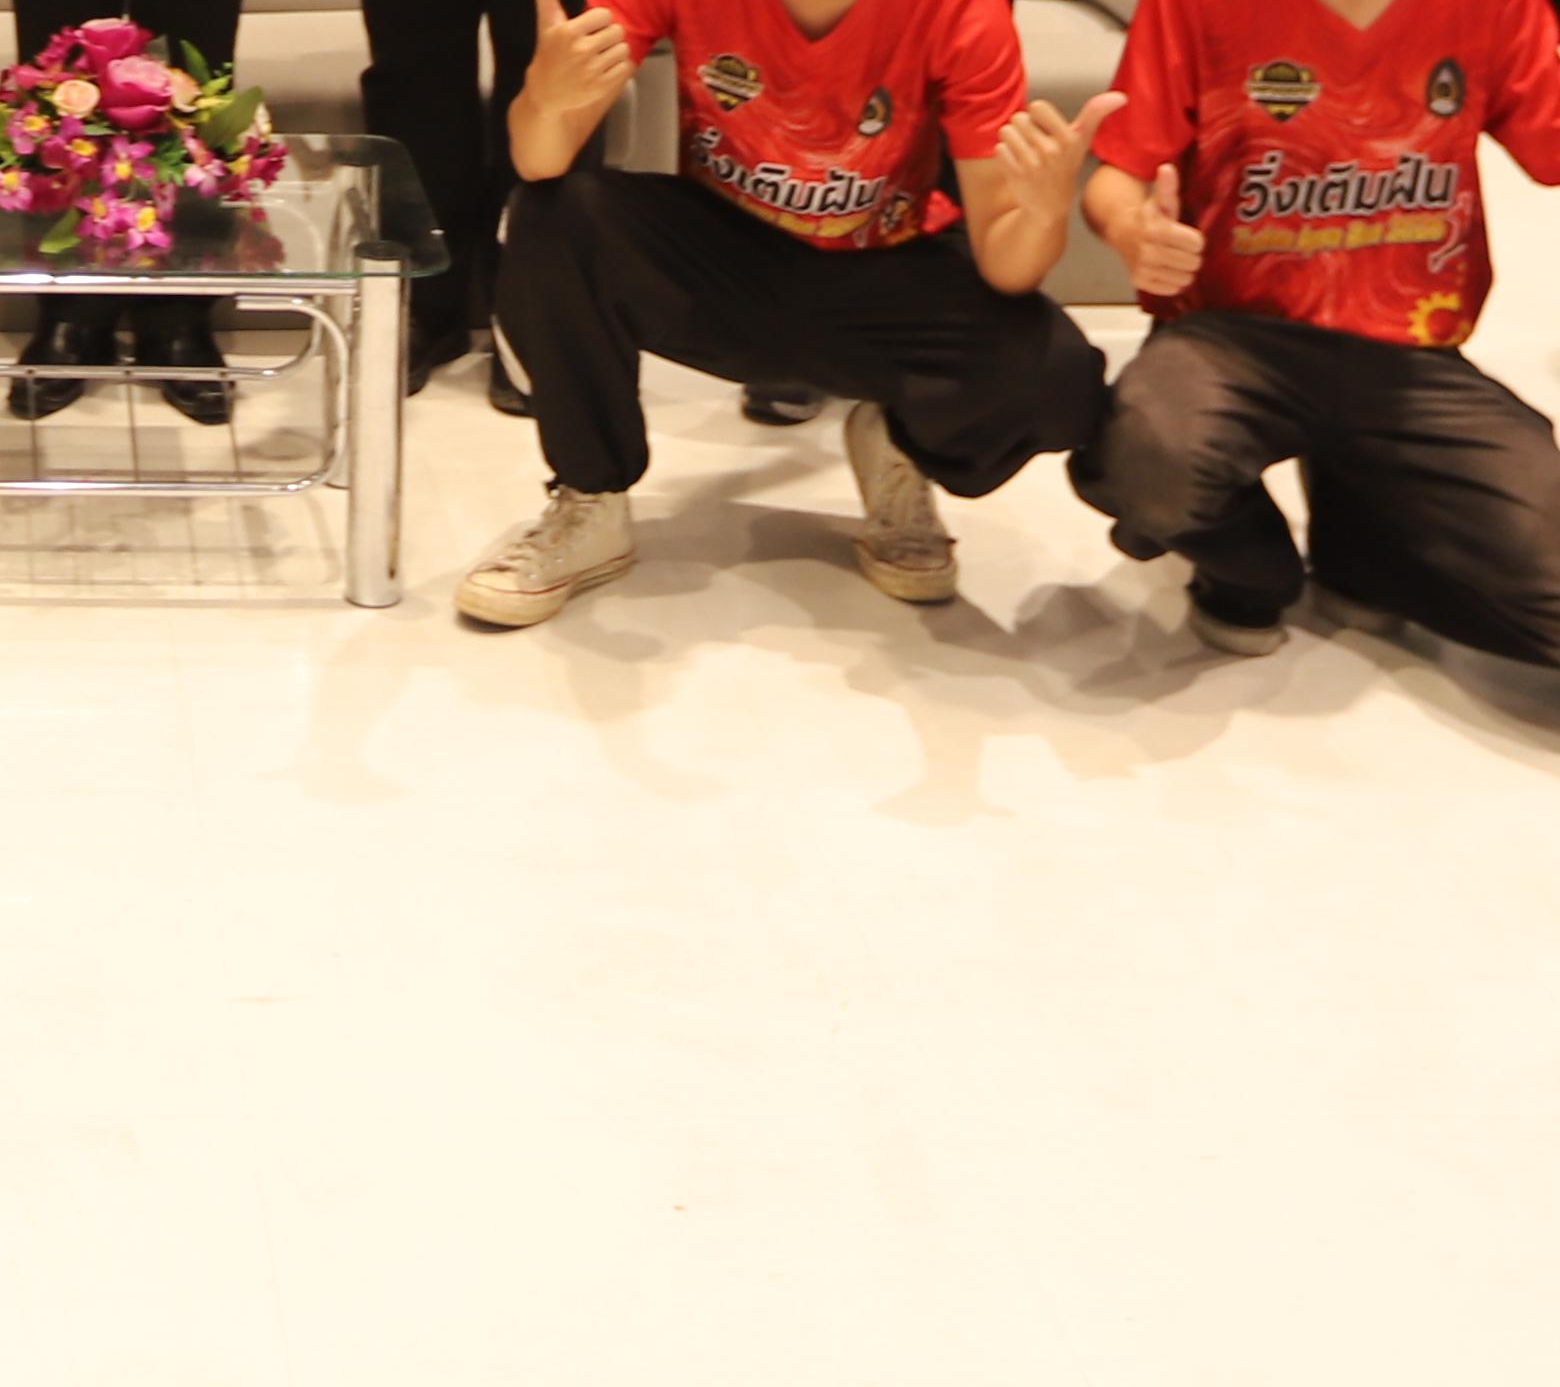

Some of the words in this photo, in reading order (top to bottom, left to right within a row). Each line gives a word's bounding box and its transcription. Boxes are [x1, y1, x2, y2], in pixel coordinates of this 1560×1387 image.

[1236, 148, 1460, 223] วิ่งเติมฝัน
